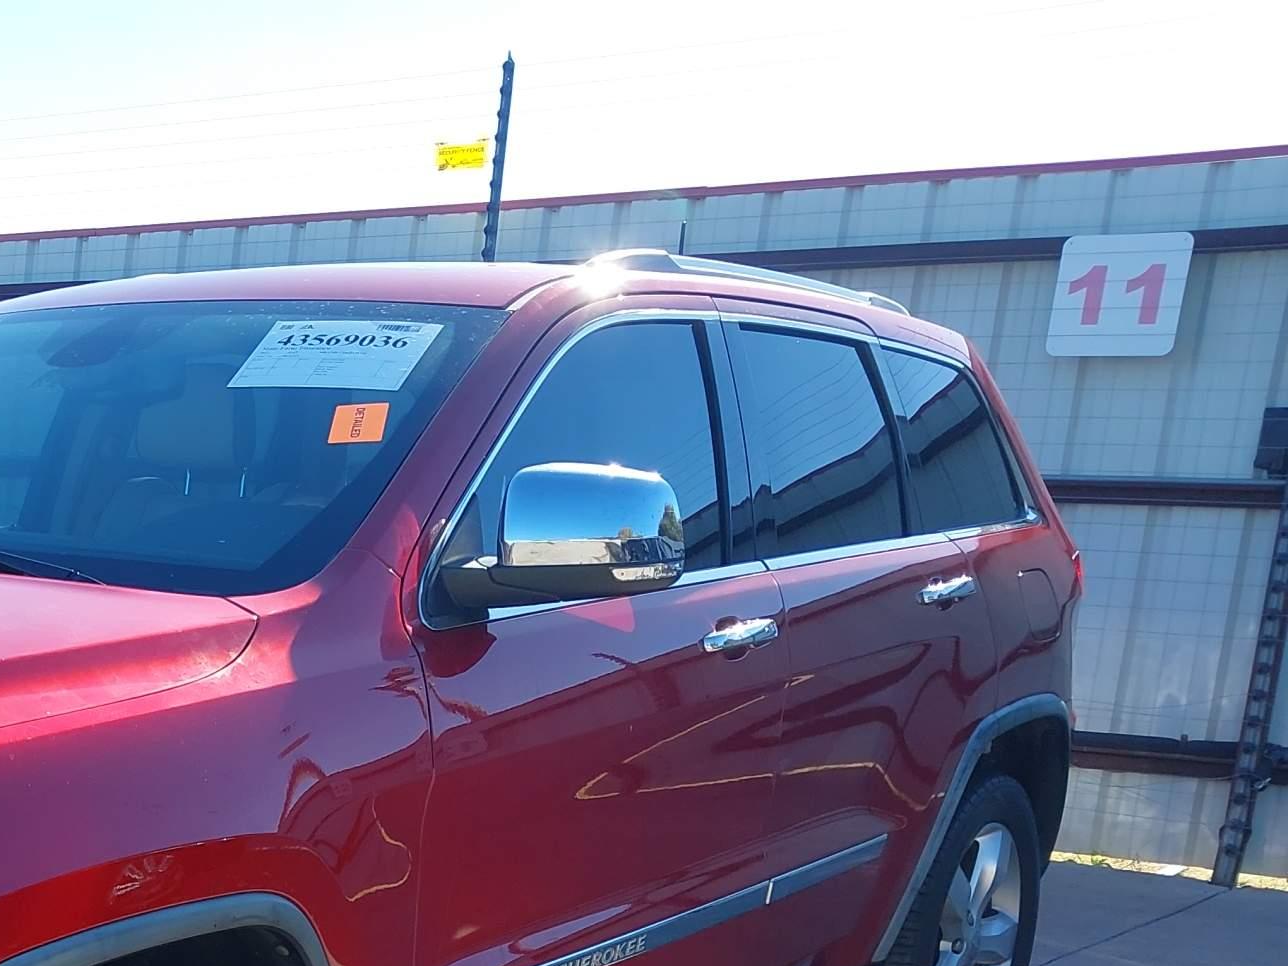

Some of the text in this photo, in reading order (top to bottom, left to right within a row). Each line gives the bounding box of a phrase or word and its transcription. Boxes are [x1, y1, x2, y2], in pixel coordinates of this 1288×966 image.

[1067, 263, 1167, 325] 11
[277, 333, 409, 349] 43569036
[349, 407, 367, 438] DETAILED
